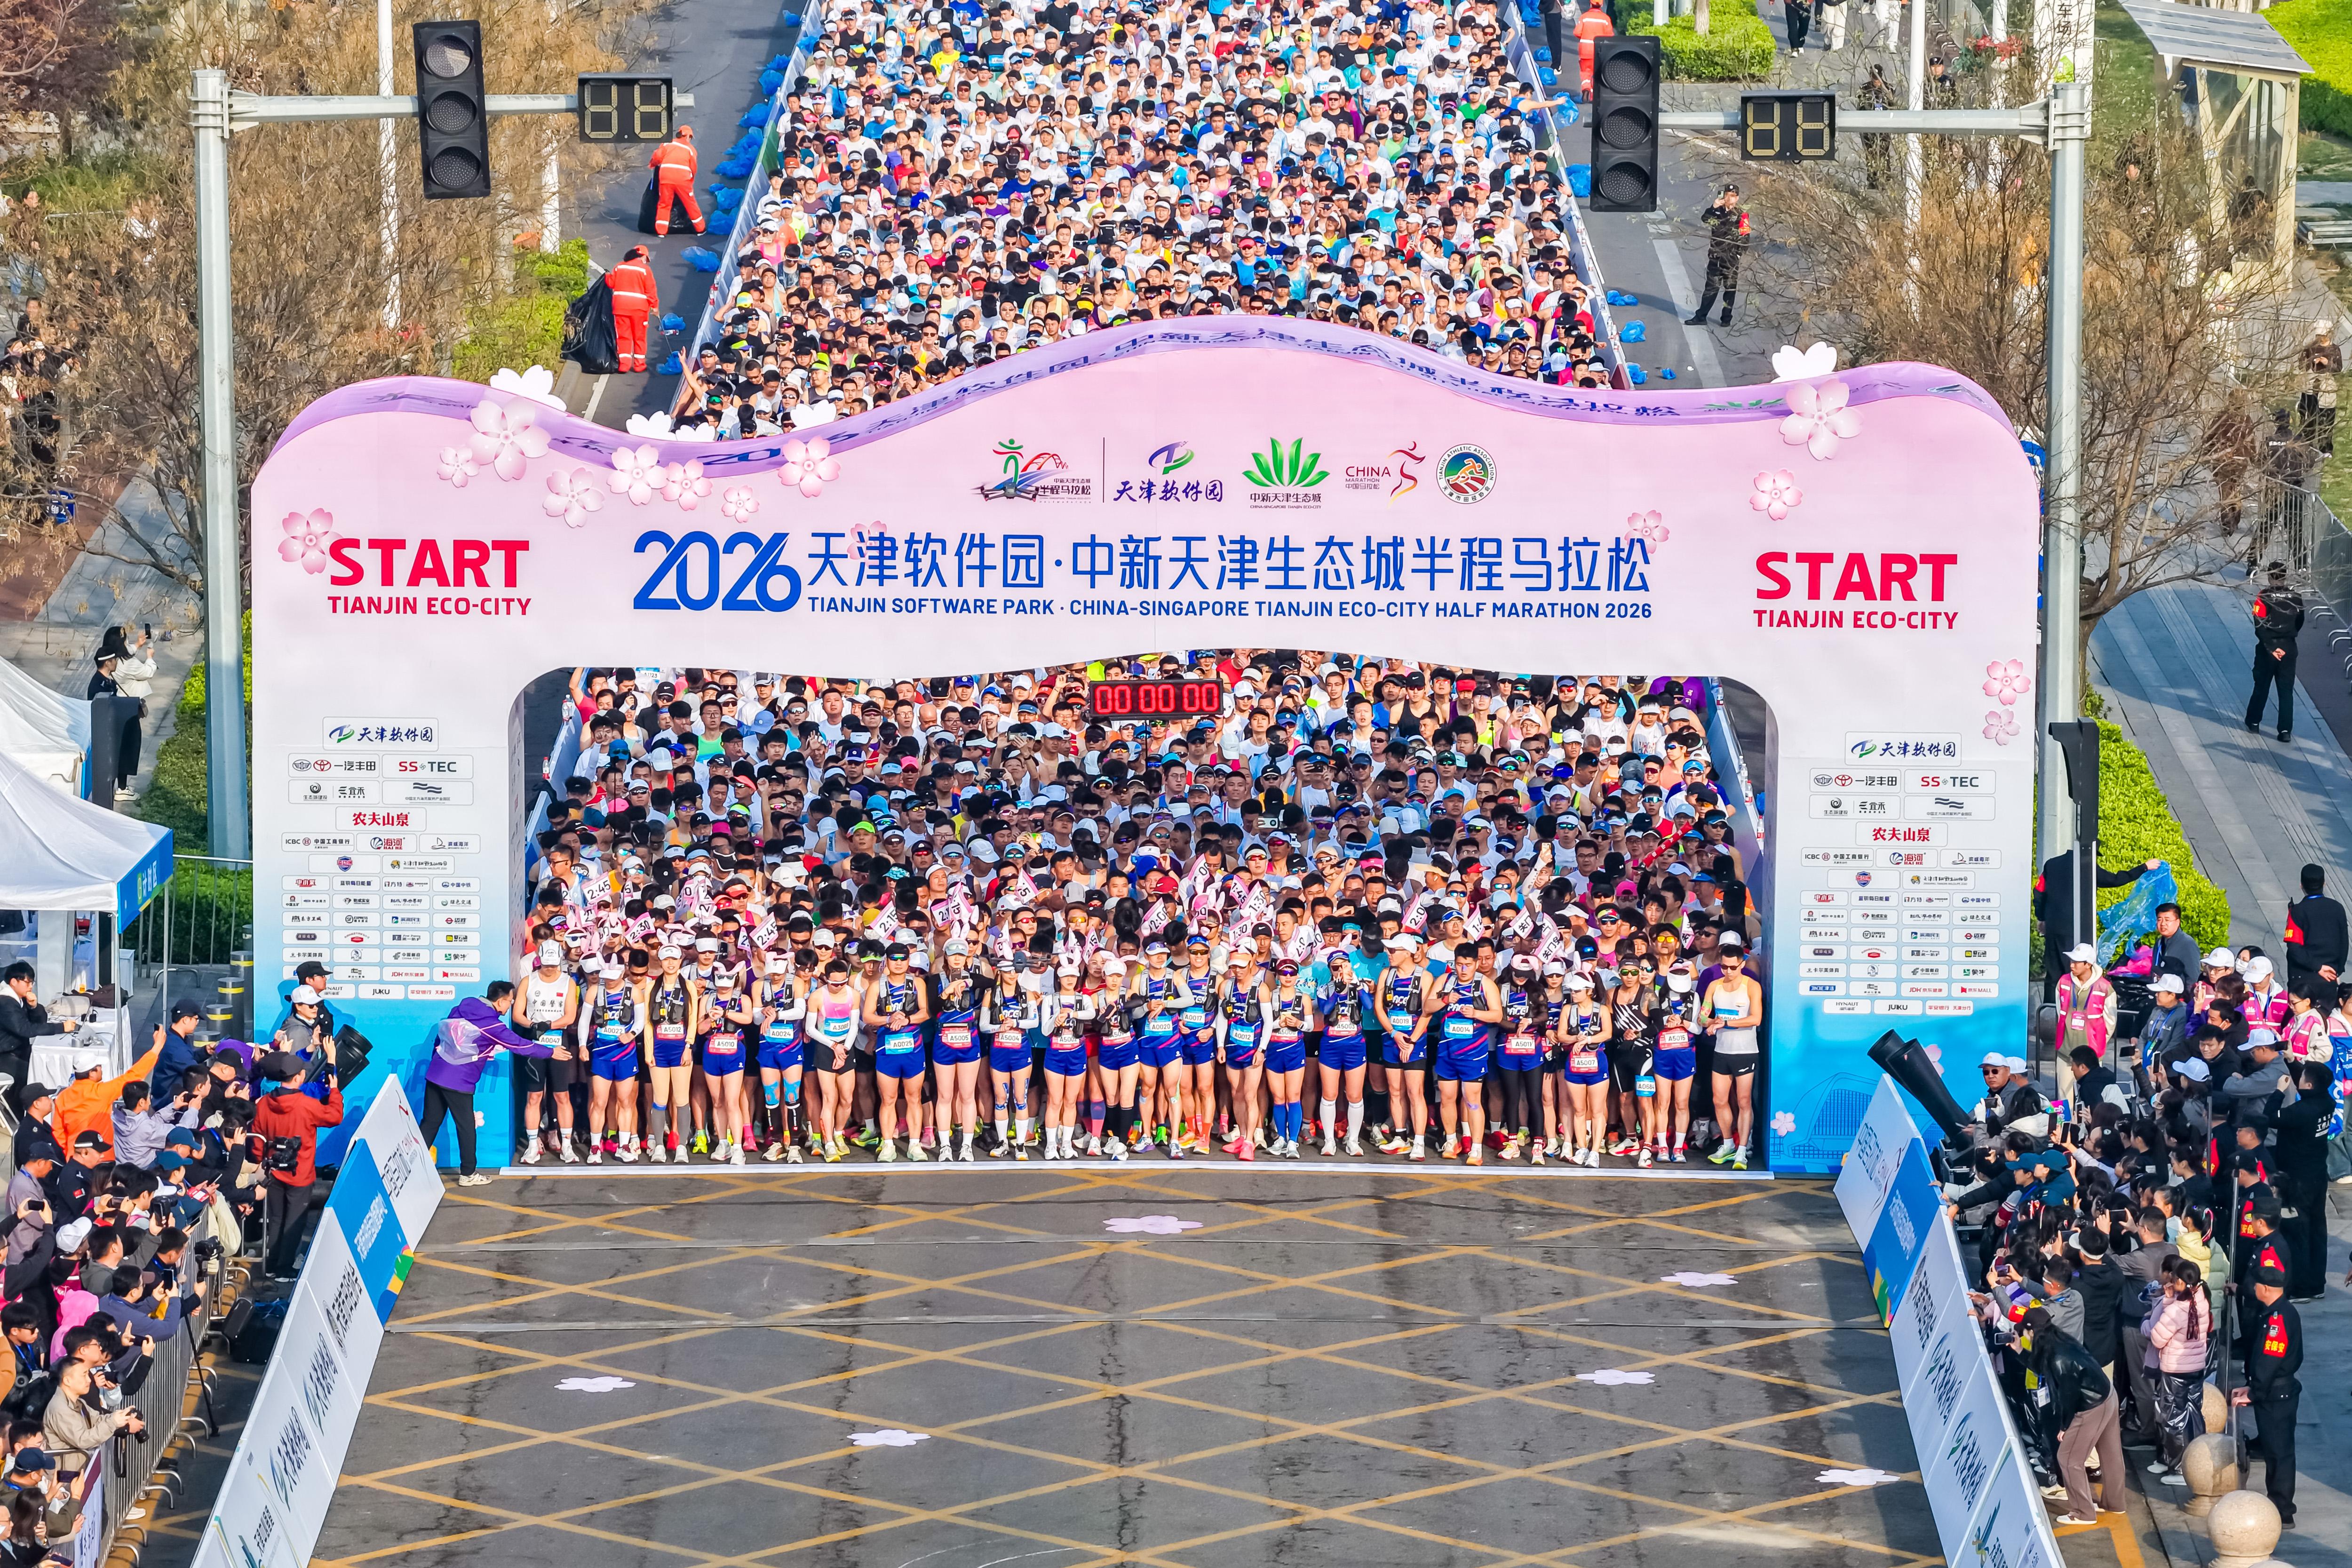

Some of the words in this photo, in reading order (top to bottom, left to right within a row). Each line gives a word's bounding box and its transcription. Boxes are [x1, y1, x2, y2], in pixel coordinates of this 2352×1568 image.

[1346, 466, 1391, 478] CHINA
[1438, 457, 1447, 480] TIANJIN
[1446, 446, 1472, 459] ATHLETIC
[1472, 448, 1495, 481] ASSOCIATION
[1040, 485, 1091, 495] 半程马拉松
[1113, 478, 1223, 504] 天津软件园
[1250, 493, 1321, 502] 中新天津生态城
[330, 538, 530, 588] START
[808, 532, 1651, 591] 天津软件园·中新天津生态城半程马拉松
[633, 530, 801, 612] 2026
[1756, 551, 1958, 602] START
[328, 596, 418, 614] TIANJIN
[427, 597, 532, 615] ECO-CITY
[808, 597, 885, 613] TIANJIN
[892, 598, 997, 614] SOFTWARE
[1004, 599, 1054, 614] PARK
[1070, 600, 1248, 616] CHINA-SINGAPORE
[1255, 602, 1332, 616] TIANJIN
[1340, 602, 1429, 617] ECO-CITY
[1436, 602, 1486, 617] HALF
[1493, 603, 1599, 618] MARATHON
[1606, 603, 1651, 618] 2026
[1753, 610, 1843, 629] TIANJIN
[1853, 611, 1959, 629] ECO-CITY
[358, 726, 432, 743] 天津软件园
[1879, 741, 1955, 758] 天津软件园
[334, 761, 376, 771] 一汽丰田
[428, 762, 456, 772] TEC
[1855, 776, 1897, 786] 一汽丰田
[1950, 777, 1979, 787] TEC
[352, 812, 410, 828] 农夫山泉
[382, 838, 403, 847] 海河
[1872, 827, 1931, 842] 农夫山泉
[1904, 853, 1924, 862] 海河
[630, 920, 651, 939] 2:30
[1232, 923, 1248, 940] 1:30
[310, 1332, 338, 1417] 天津软件园
[1931, 1349, 1962, 1426] 天津软件园
[278, 1406, 311, 1493] 天津软件园
[1954, 1430, 1986, 1512] 天津软件园
